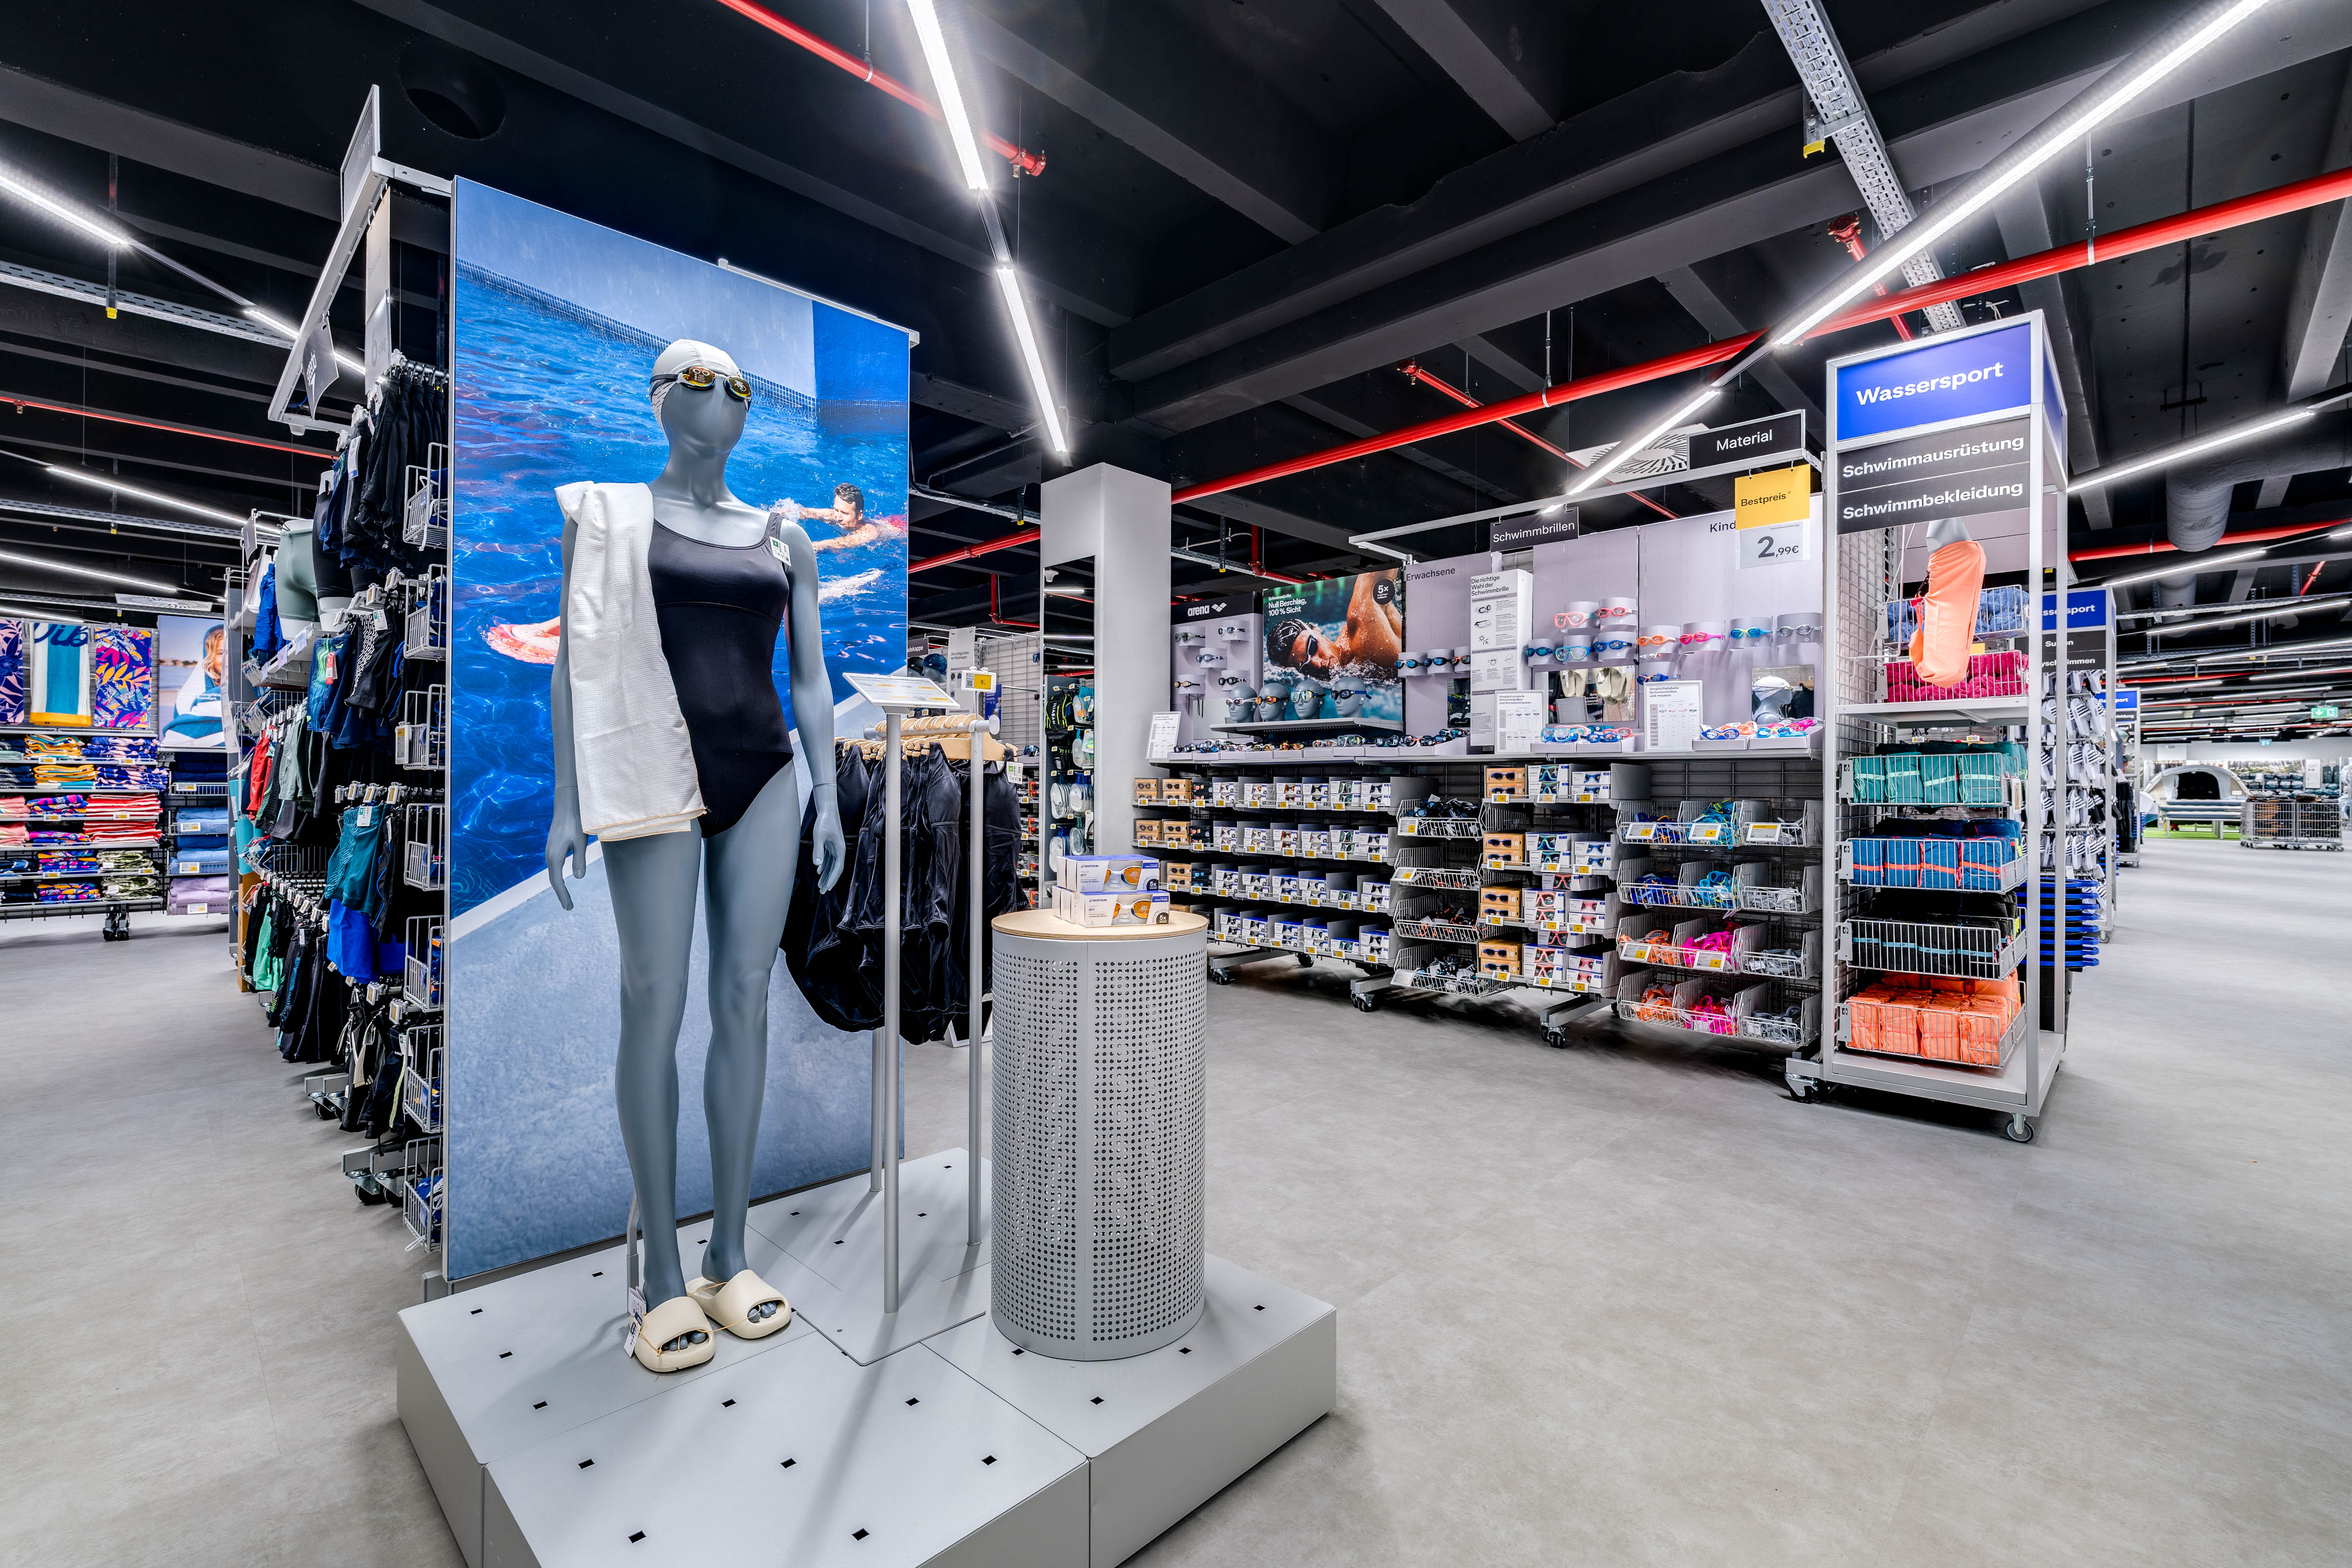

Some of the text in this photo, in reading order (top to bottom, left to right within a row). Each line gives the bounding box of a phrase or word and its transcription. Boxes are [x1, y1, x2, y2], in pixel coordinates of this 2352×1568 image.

[1856, 362, 2003, 405] Wassersport
[1716, 429, 1772, 451] Material
[1843, 437, 2024, 478] Schwimmausrüstung
[1741, 492, 1786, 506] Bestpreis
[1843, 483, 2023, 519] Schwimmbekleidung
[1493, 522, 1575, 542] Schwimmbrillen
[1710, 520, 1736, 533] Kind
[1758, 536, 1799, 558] 2,99€
[1406, 568, 1455, 581] Erwachsene
[1471, 586, 1509, 596] Schwimmbrille
[1187, 605, 1210, 616] arena
[1279, 598, 1307, 607] Beschlag,
